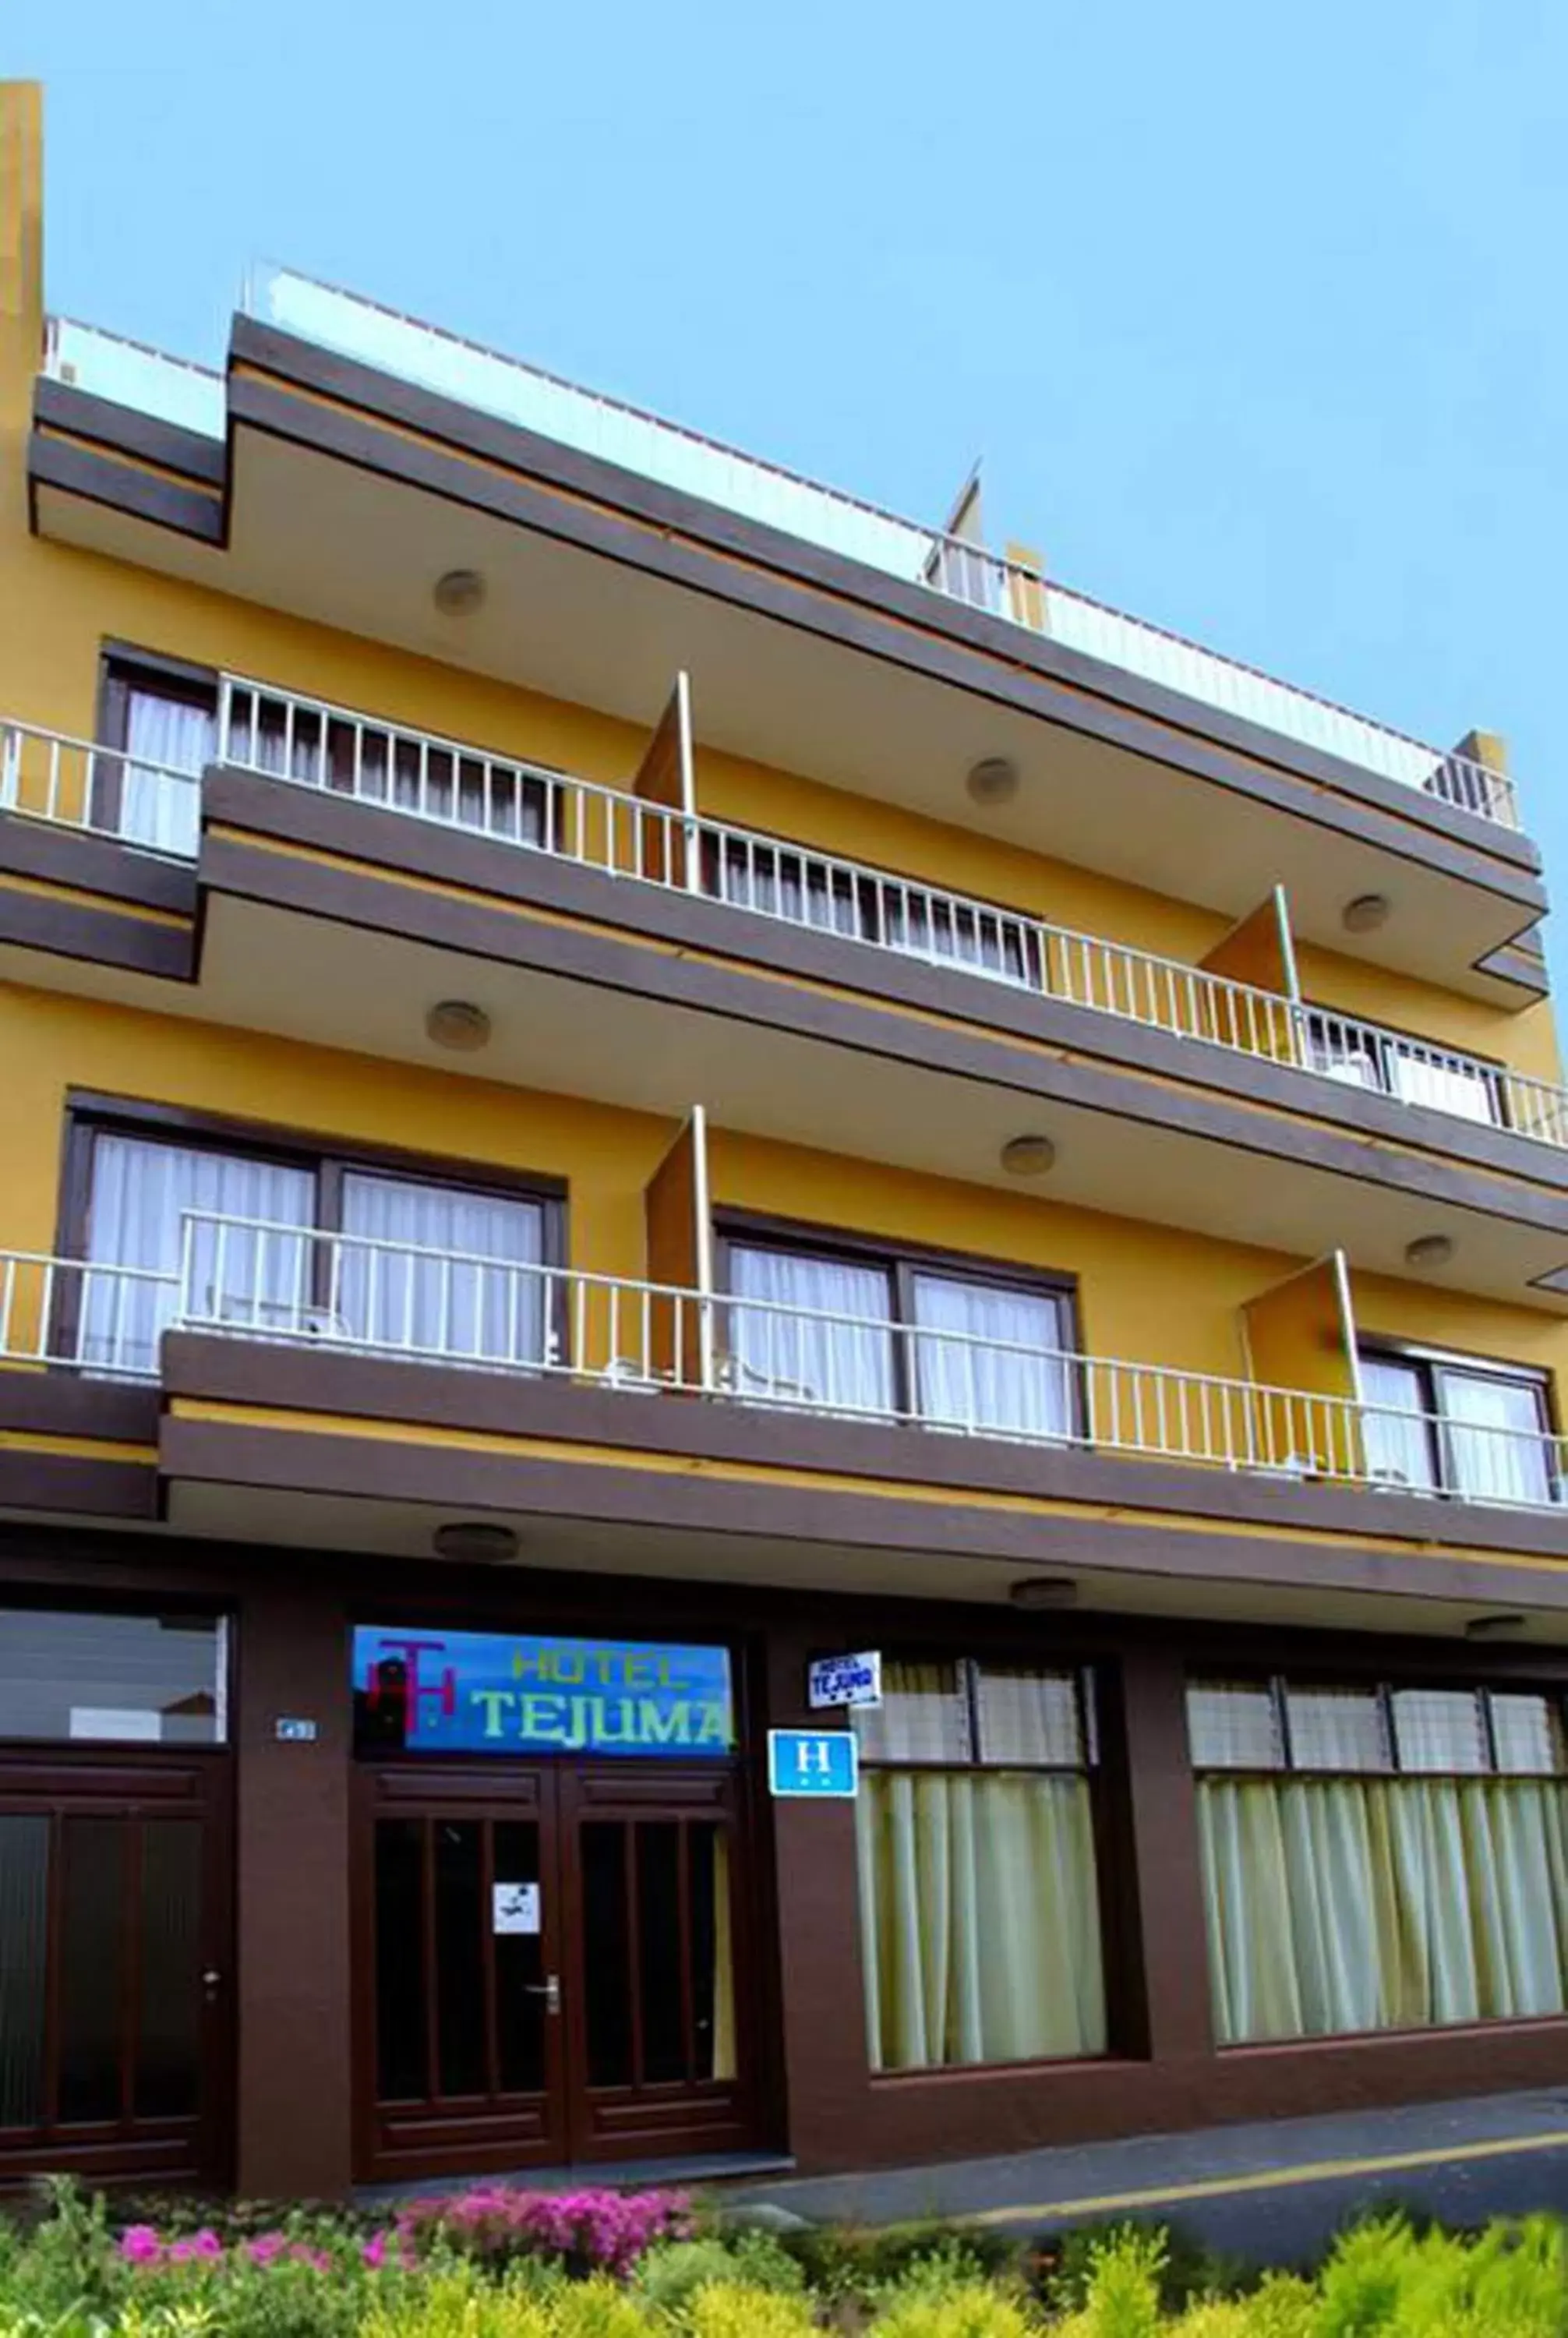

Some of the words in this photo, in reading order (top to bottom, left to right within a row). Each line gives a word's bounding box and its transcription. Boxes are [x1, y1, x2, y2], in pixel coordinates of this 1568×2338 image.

[511, 1643, 690, 1691] HOTEL
[470, 1689, 737, 1750] TEJUMA
[796, 1740, 832, 1774] H
